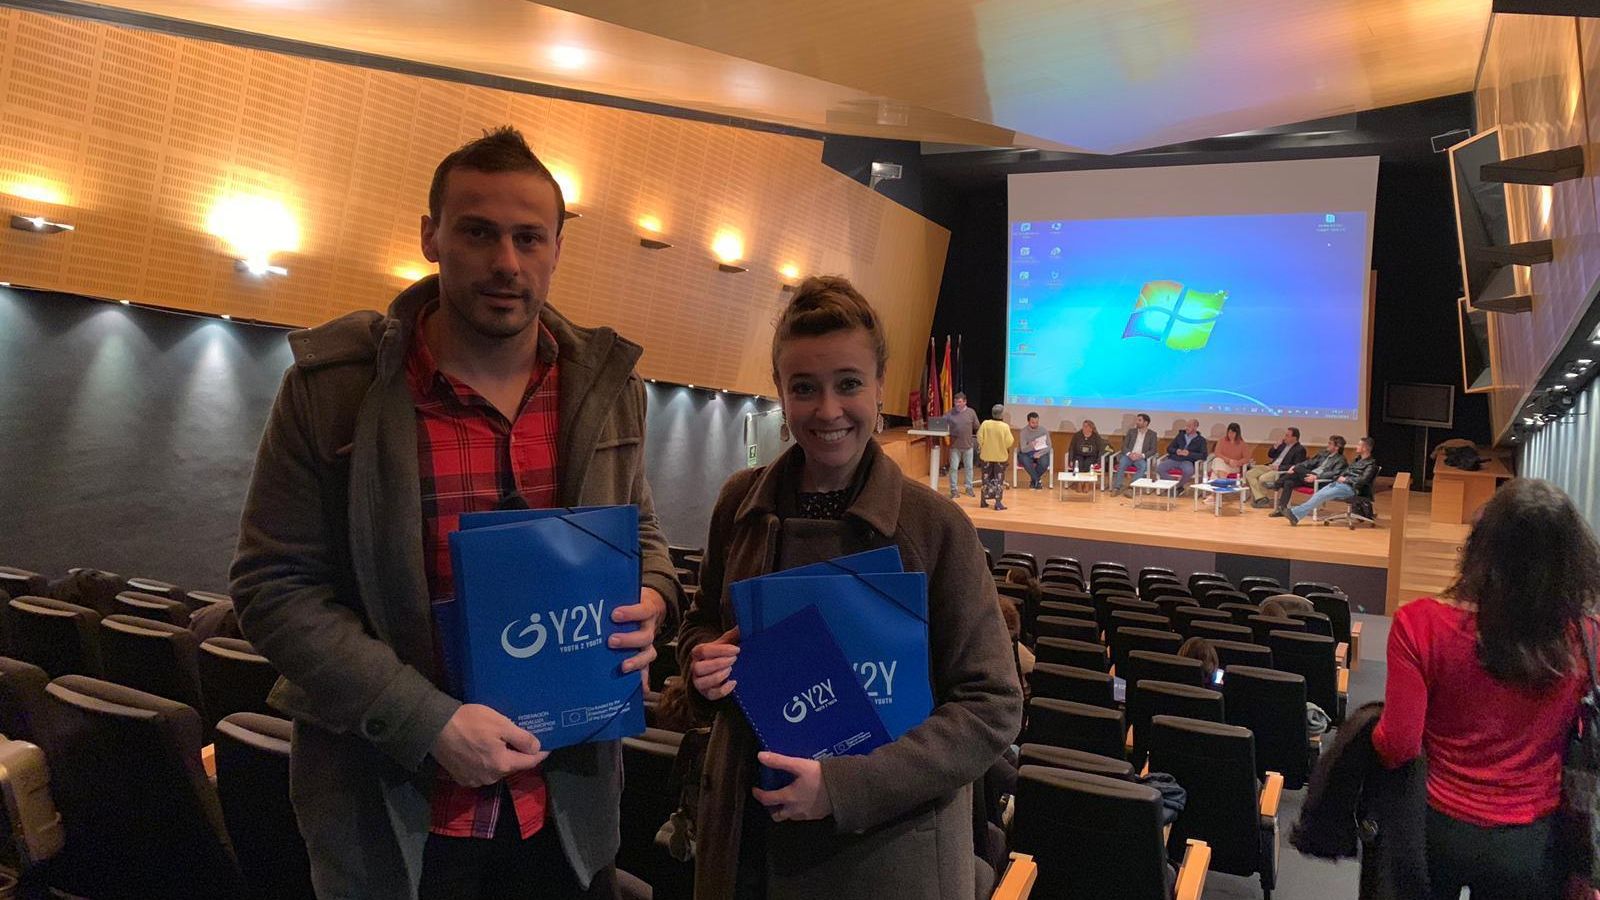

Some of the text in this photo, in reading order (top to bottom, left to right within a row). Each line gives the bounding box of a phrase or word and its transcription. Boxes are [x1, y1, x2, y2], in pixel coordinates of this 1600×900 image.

[548, 599, 605, 645] Y2Y
[560, 644, 579, 654] YOUTH
[586, 637, 603, 648] YOUTH
[801, 678, 836, 709] Y2Y
[852, 660, 897, 697] 2Y
